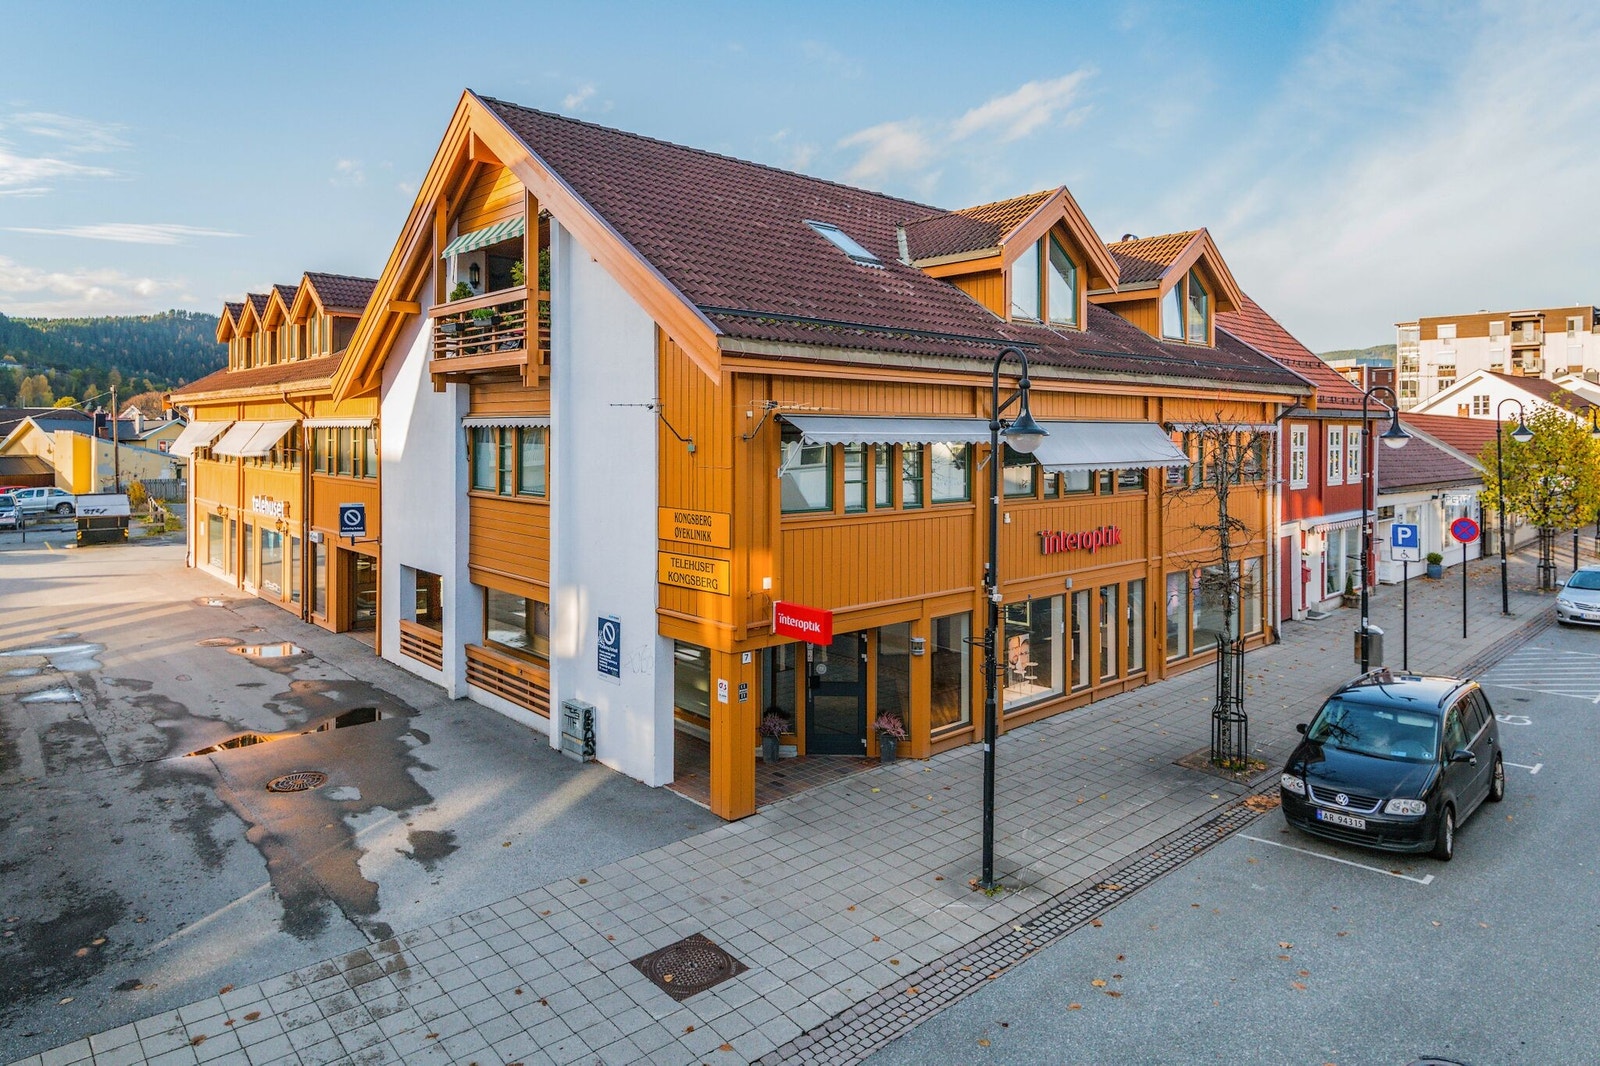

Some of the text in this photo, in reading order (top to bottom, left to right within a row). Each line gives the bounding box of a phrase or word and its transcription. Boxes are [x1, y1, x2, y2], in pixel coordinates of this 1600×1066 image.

[674, 512, 712, 527] KONGSBERG
[1397, 527, 1412, 545] P
[670, 557, 715, 574] TELEHUSET
[668, 571, 718, 590] KONGSBERG
[1323, 812, 1363, 828] AR 94315
